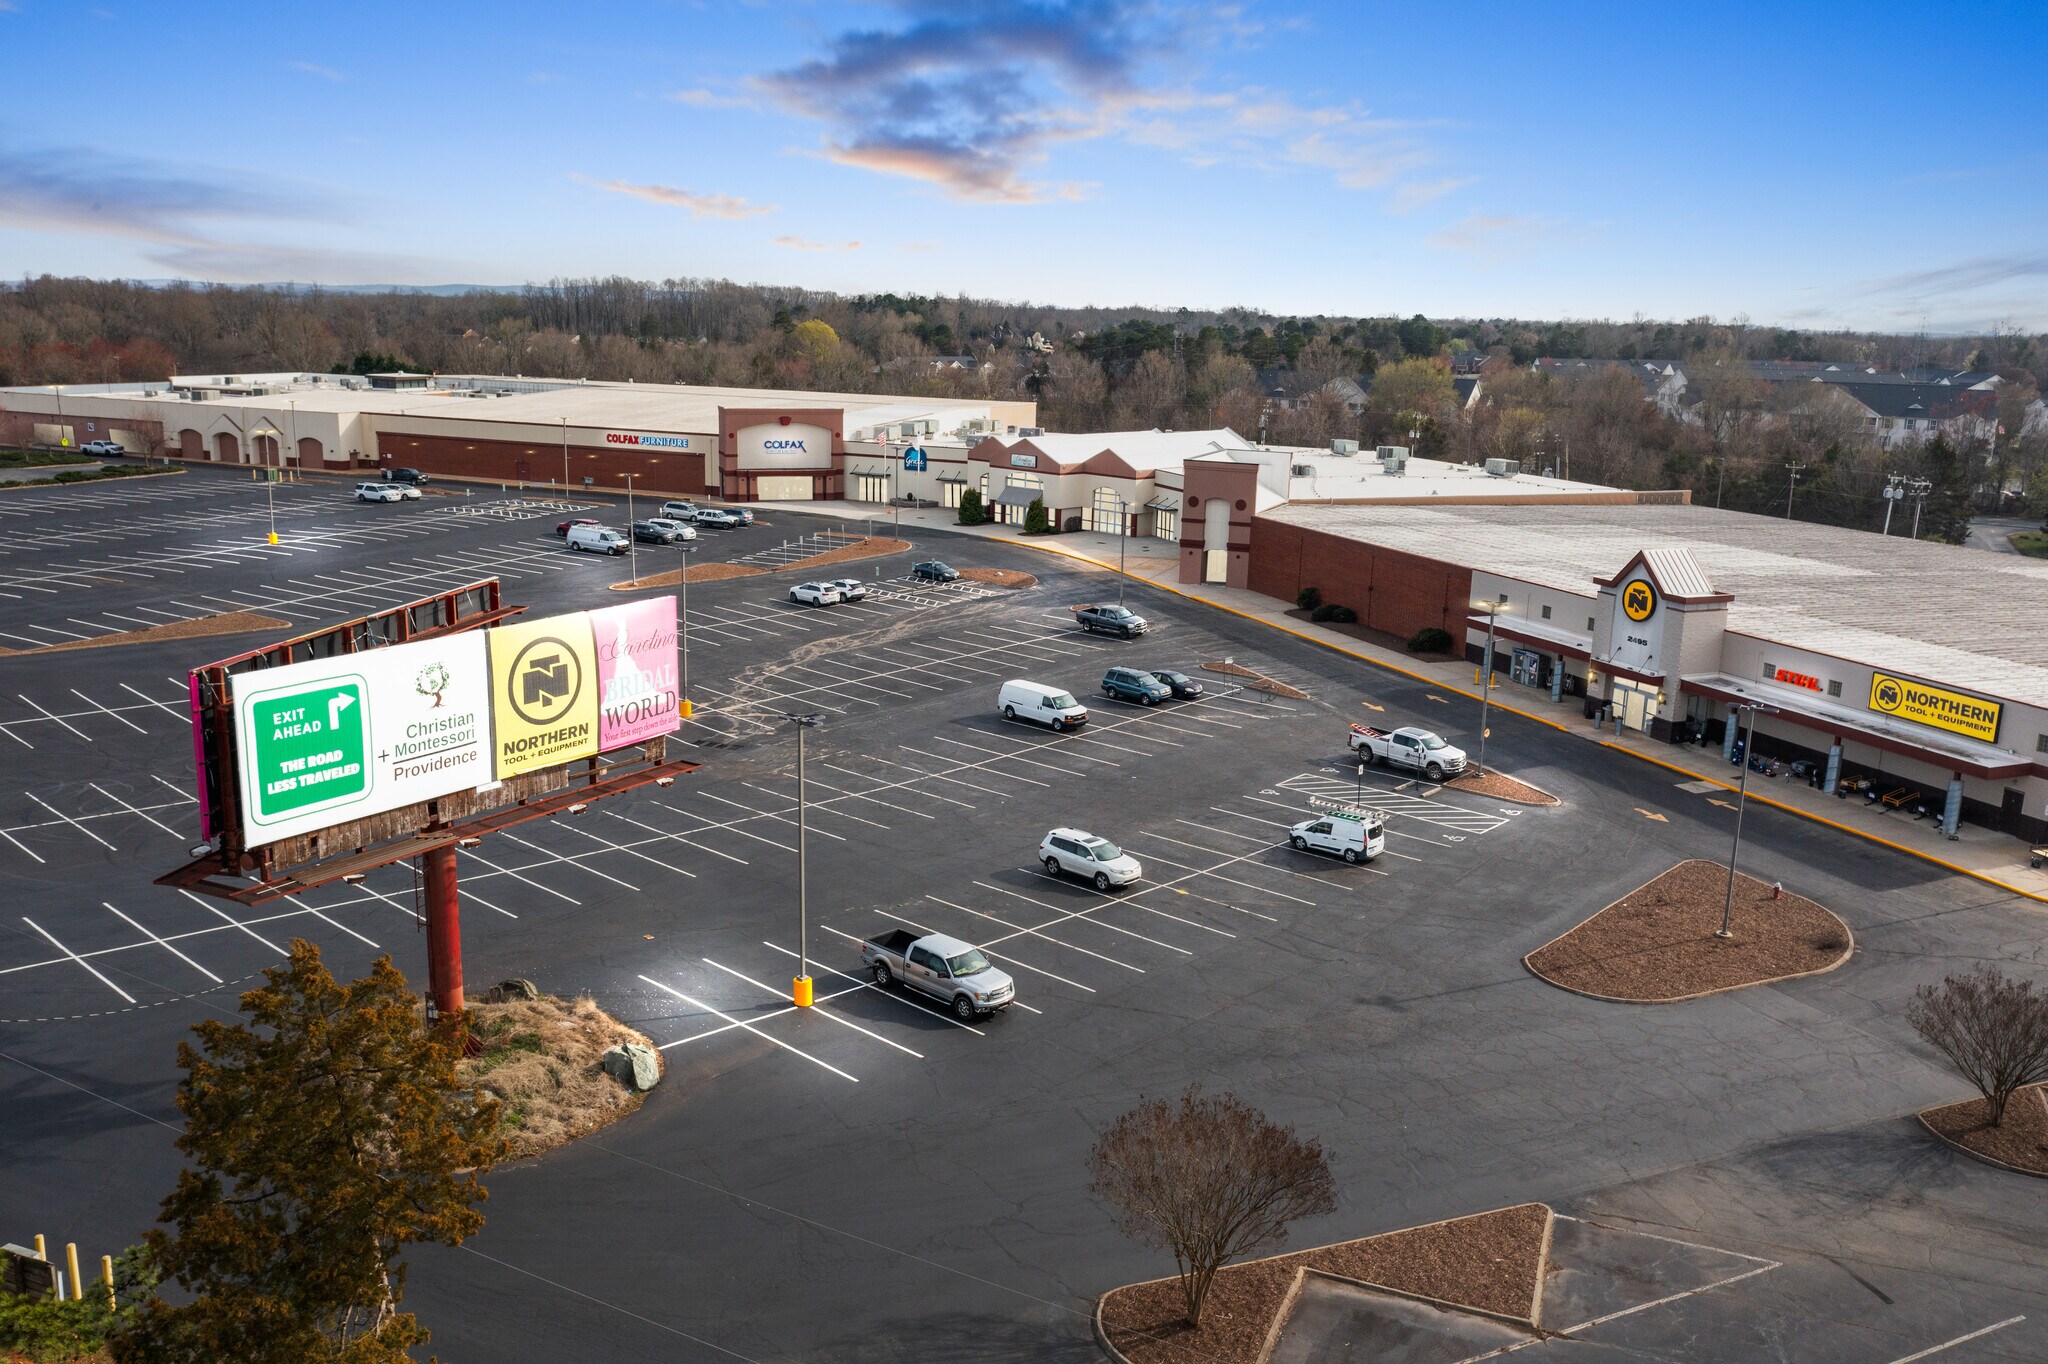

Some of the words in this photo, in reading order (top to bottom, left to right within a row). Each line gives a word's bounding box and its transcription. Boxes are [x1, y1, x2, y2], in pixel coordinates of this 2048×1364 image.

[606, 433, 639, 445] COLFAX
[640, 436, 689, 448] FURNITURE
[764, 440, 807, 453] COLFAX
[600, 629, 676, 661] Carolina
[1627, 635, 1648, 646] 2495
[604, 663, 675, 702] BRIDAL
[1775, 669, 1822, 691] STIHL
[273, 708, 306, 725] EXIT
[605, 690, 676, 730] WORLD
[1905, 689, 1995, 724] NORTHERN
[1905, 705, 1928, 716] TOOL
[1937, 713, 1993, 733] EQUIPMENT
[273, 720, 322, 740] AHEAD
[406, 711, 475, 739] Christian
[503, 722, 589, 756] NORTHERN
[394, 726, 476, 758] Montessori
[504, 754, 528, 765] TOOL
[538, 737, 589, 757] EQUIPMENT
[280, 758, 306, 774] THE
[307, 750, 343, 768] ROAD
[393, 749, 478, 782] Providence
[267, 777, 298, 795] LESS
[298, 763, 360, 787] TRAVELED
